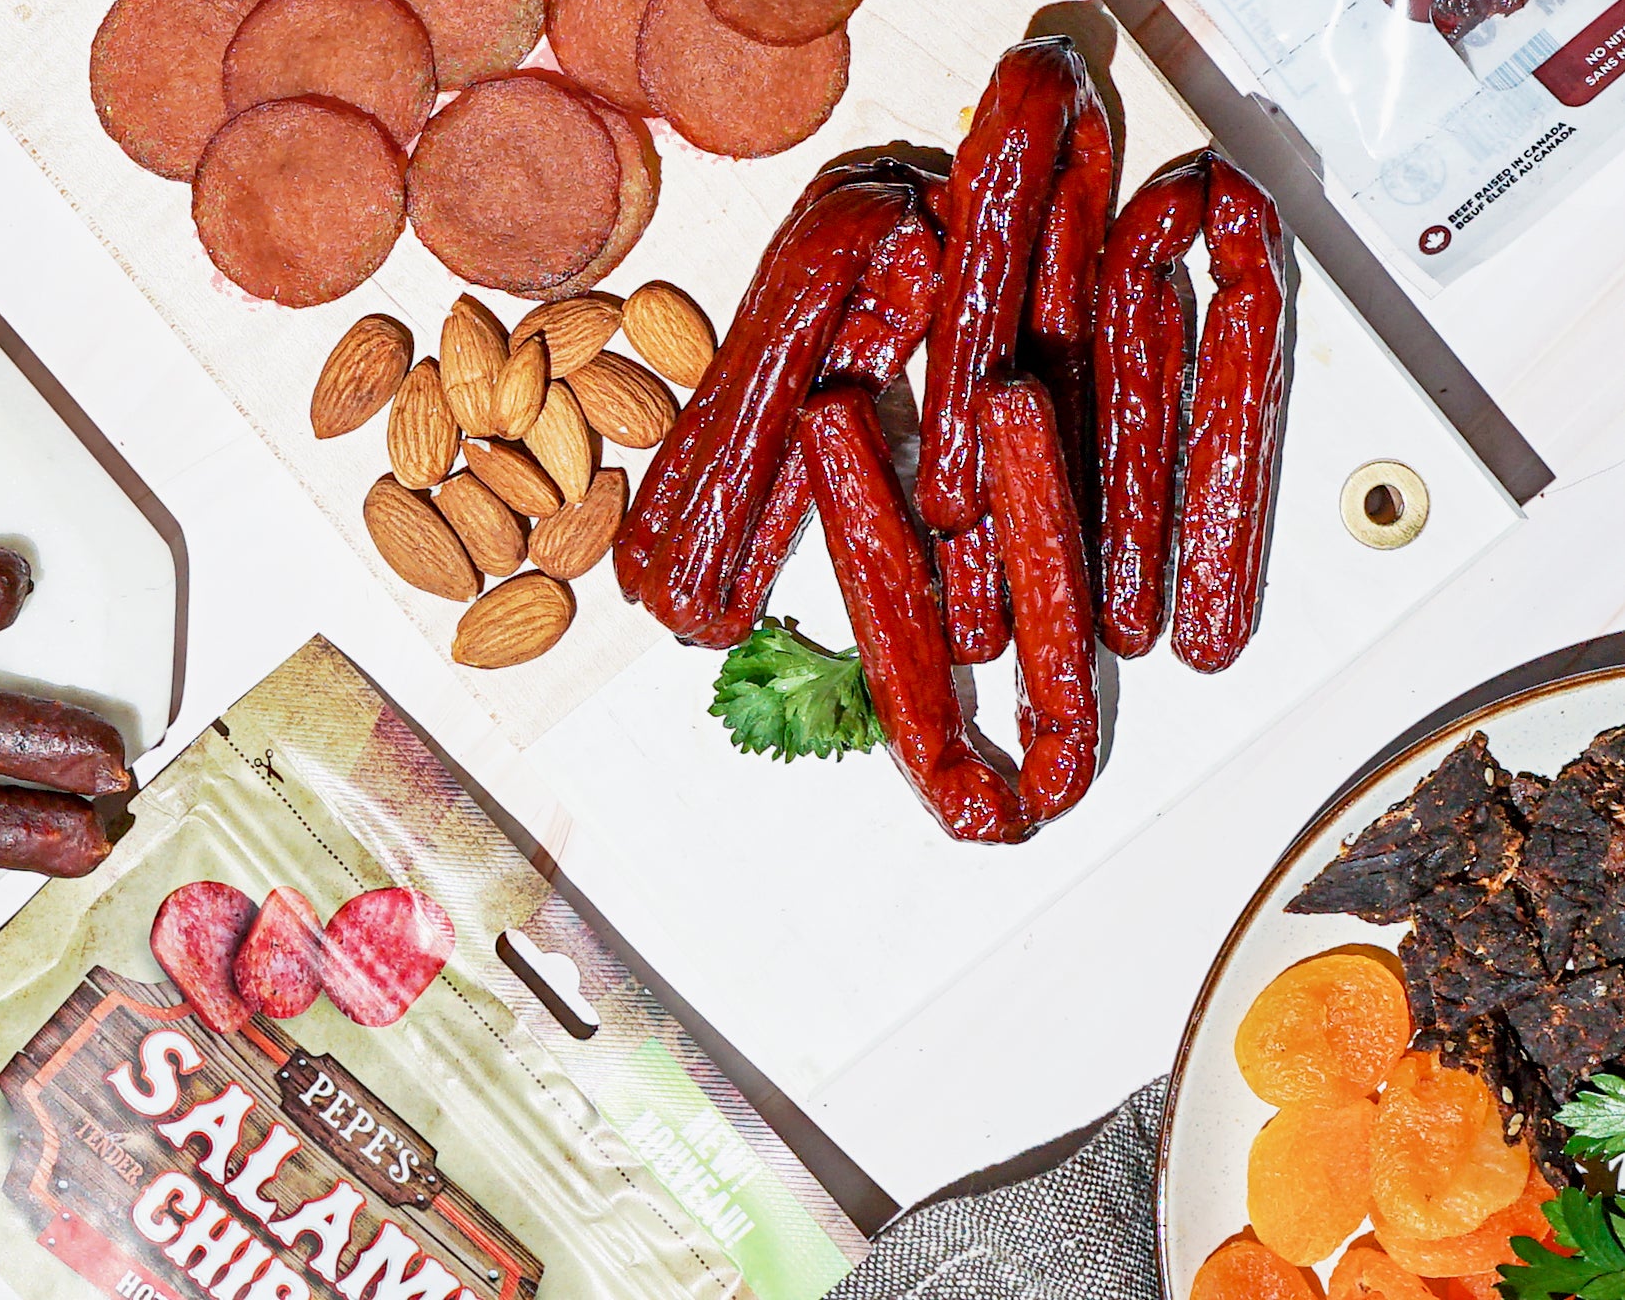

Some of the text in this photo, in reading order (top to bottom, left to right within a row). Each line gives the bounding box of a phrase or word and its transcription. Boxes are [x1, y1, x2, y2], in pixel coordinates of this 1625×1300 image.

[1584, 44, 1607, 66] NO
[1584, 55, 1619, 87] SANS
[1447, 119, 1567, 224] BEEF RAISED IN CANADA
[1517, 160, 1533, 176] AU
[1532, 123, 1577, 163] CANADA
[74, 1118, 143, 1185] TENDER
[107, 1028, 477, 1300] SALAM
[296, 1069, 425, 1188] PEPE'S
[678, 1104, 762, 1196] NEW!
[621, 1106, 755, 1252] NOUVEAU!
